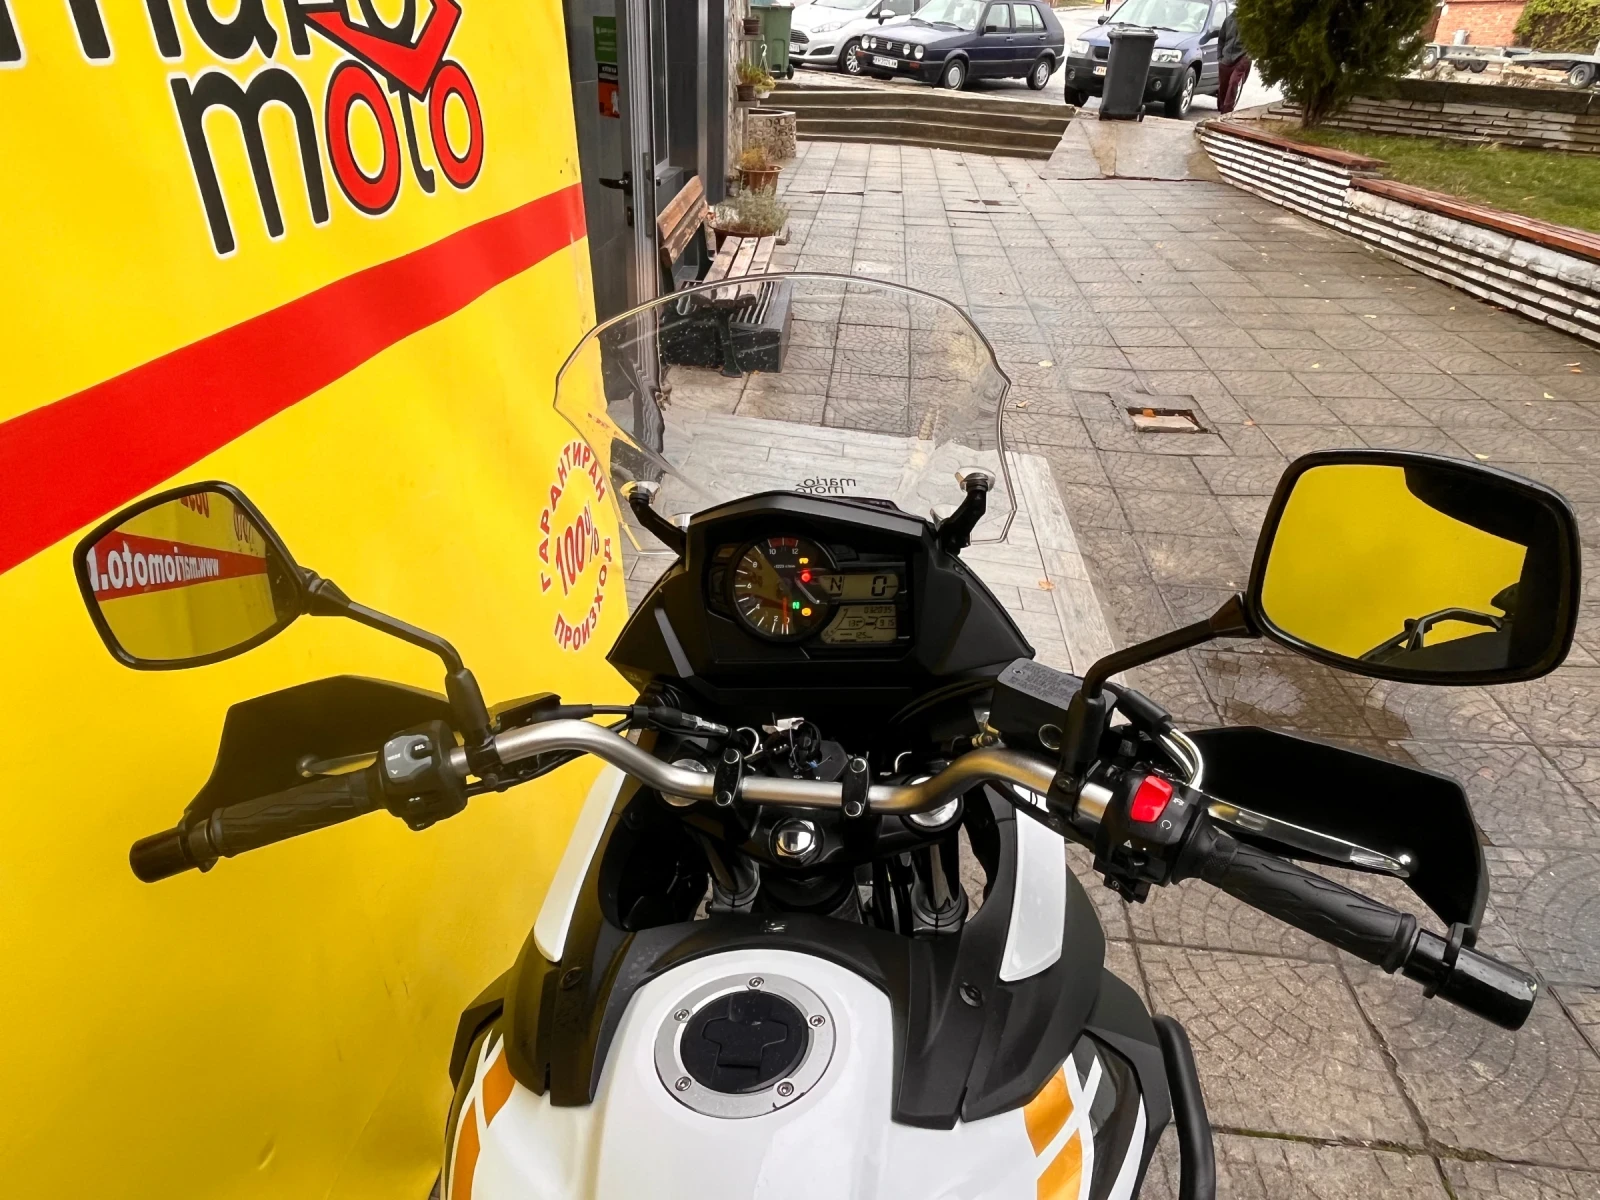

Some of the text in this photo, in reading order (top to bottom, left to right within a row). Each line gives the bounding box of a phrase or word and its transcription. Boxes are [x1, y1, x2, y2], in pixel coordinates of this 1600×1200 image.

[169, 59, 485, 255] moto
[539, 441, 606, 592] ГАРАНТИРАН
[555, 500, 600, 596] 100%
[554, 537, 612, 650] ПРОИЗХОД
[871, 576, 888, 596] 0
